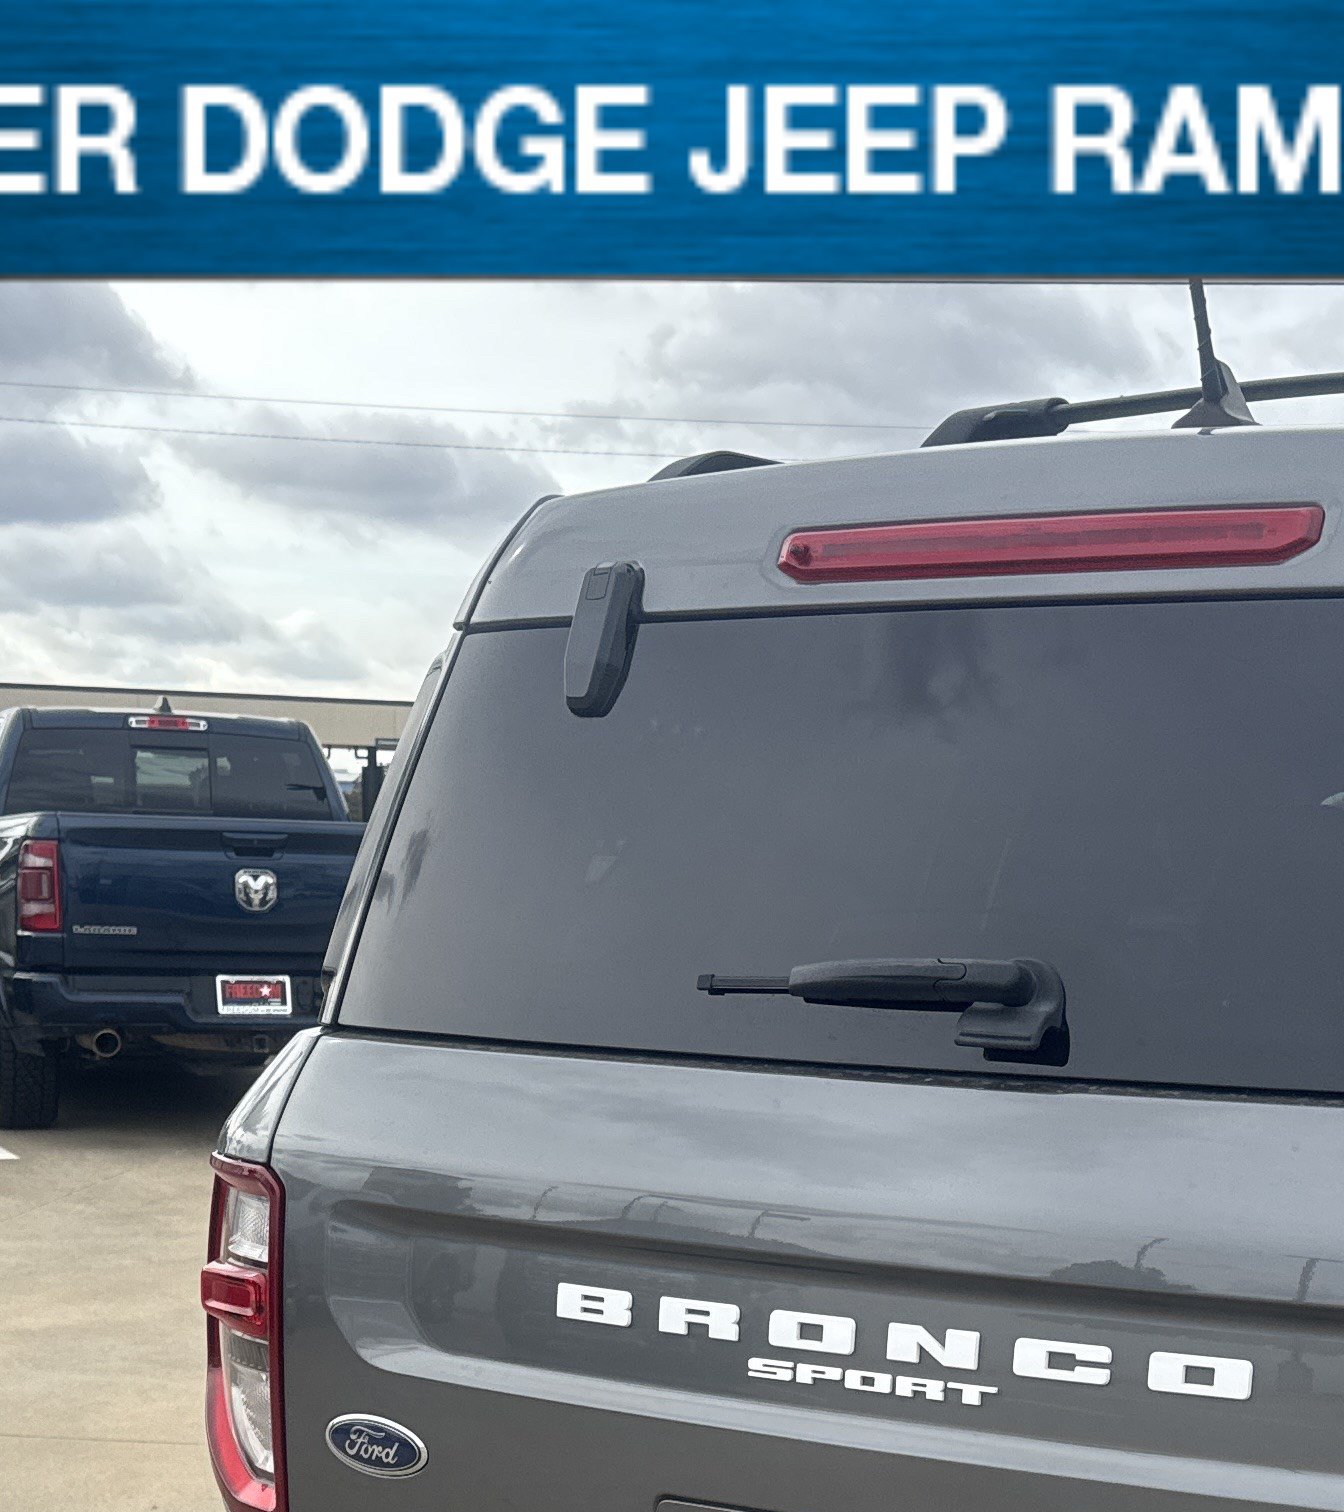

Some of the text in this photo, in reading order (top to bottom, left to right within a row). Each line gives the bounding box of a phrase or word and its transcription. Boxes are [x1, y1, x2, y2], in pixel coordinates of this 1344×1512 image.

[555, 1281, 1255, 1401] BRONCO
[746, 1355, 999, 1406] SPORT
[344, 1425, 399, 1465] Ford
